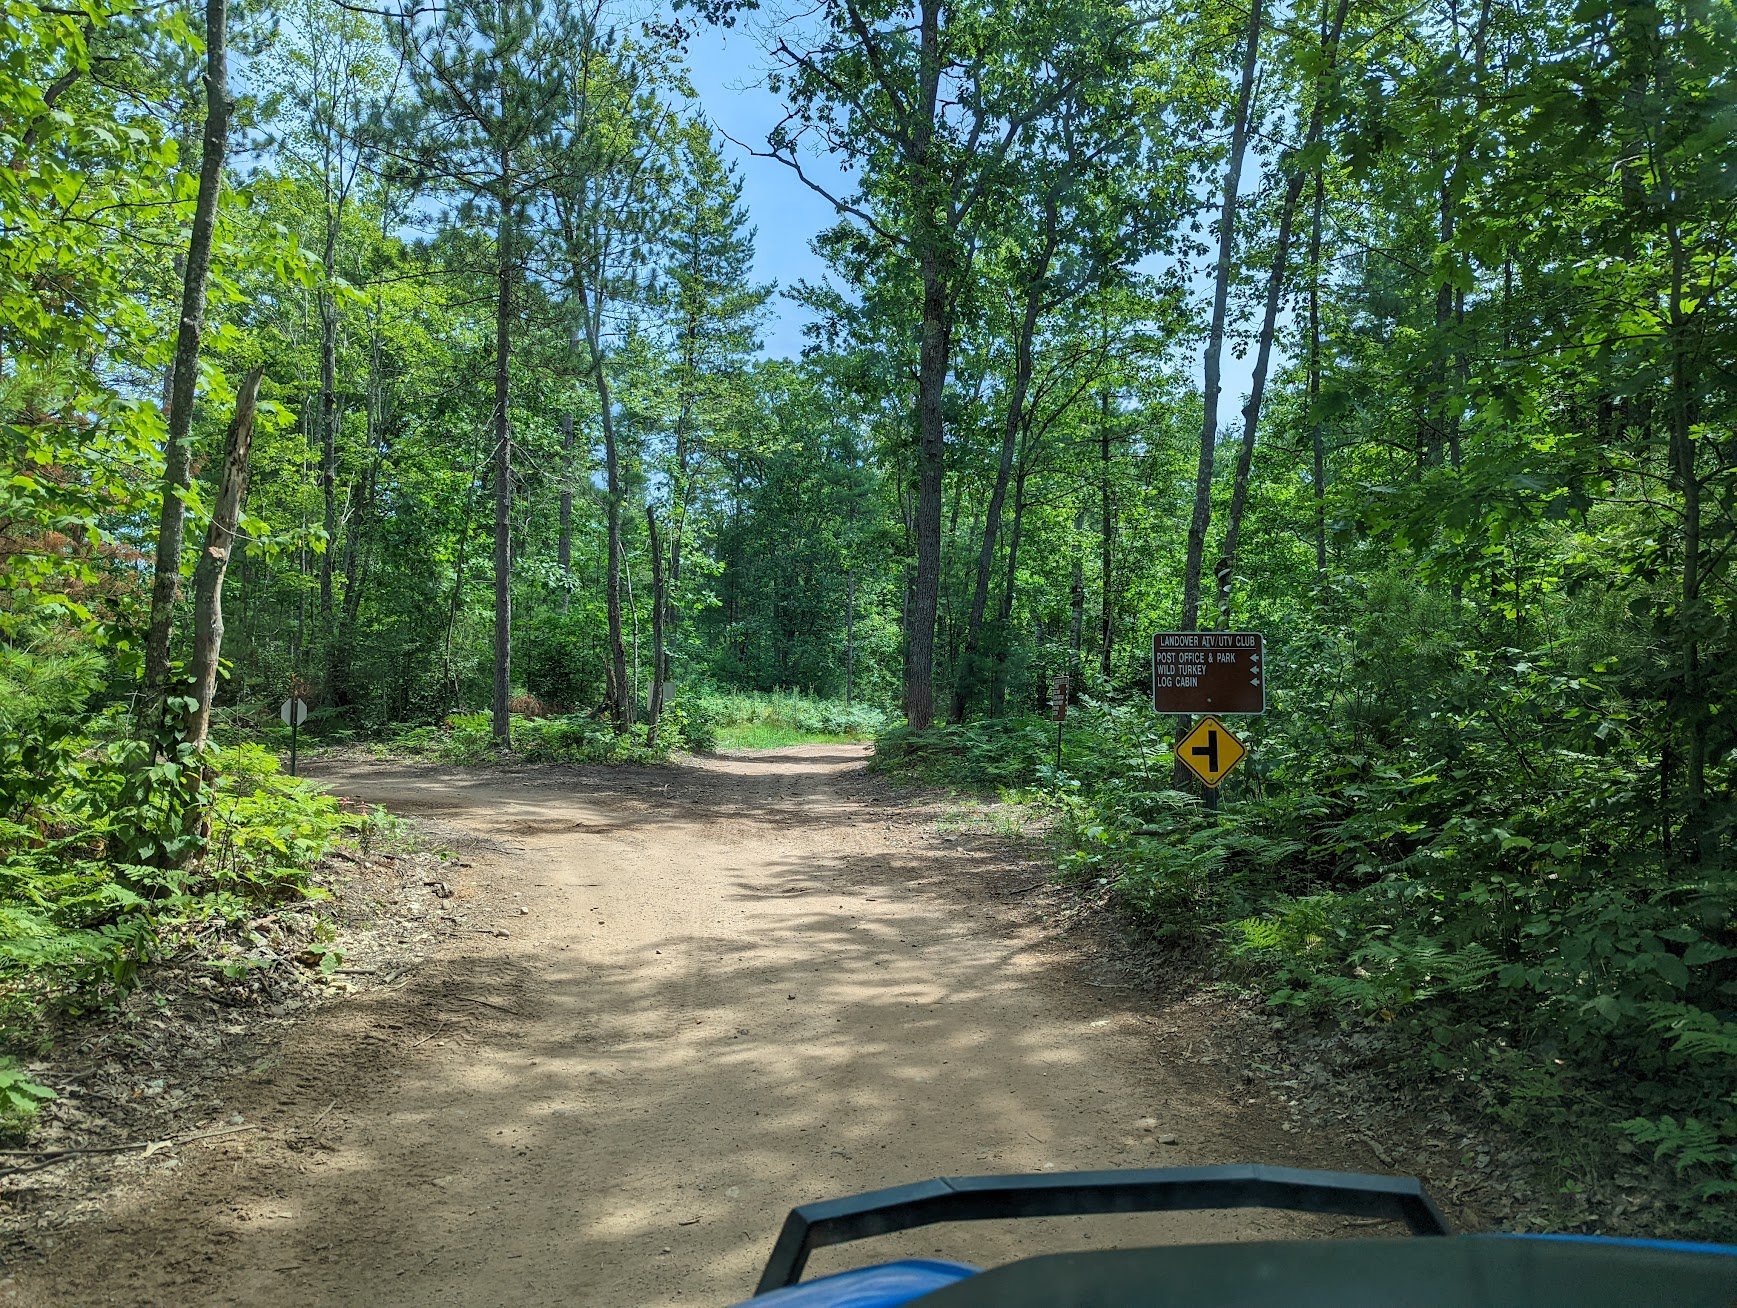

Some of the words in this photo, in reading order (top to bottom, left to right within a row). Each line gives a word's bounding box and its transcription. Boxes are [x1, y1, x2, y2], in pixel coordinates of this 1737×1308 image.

[1160, 636, 1198, 646] LANDOVER
[1202, 636, 1233, 646] ATV/UTV
[1236, 636, 1255, 646] CLUB
[1157, 653, 1175, 663] POST
[1179, 653, 1204, 663] OFFICE
[1208, 653, 1213, 663] &
[1217, 653, 1236, 663] PARK
[1157, 665, 1175, 675] WILD
[1179, 665, 1206, 675] TURKEY
[1157, 677, 1172, 687] LOG
[1176, 677, 1198, 687] CABIN
